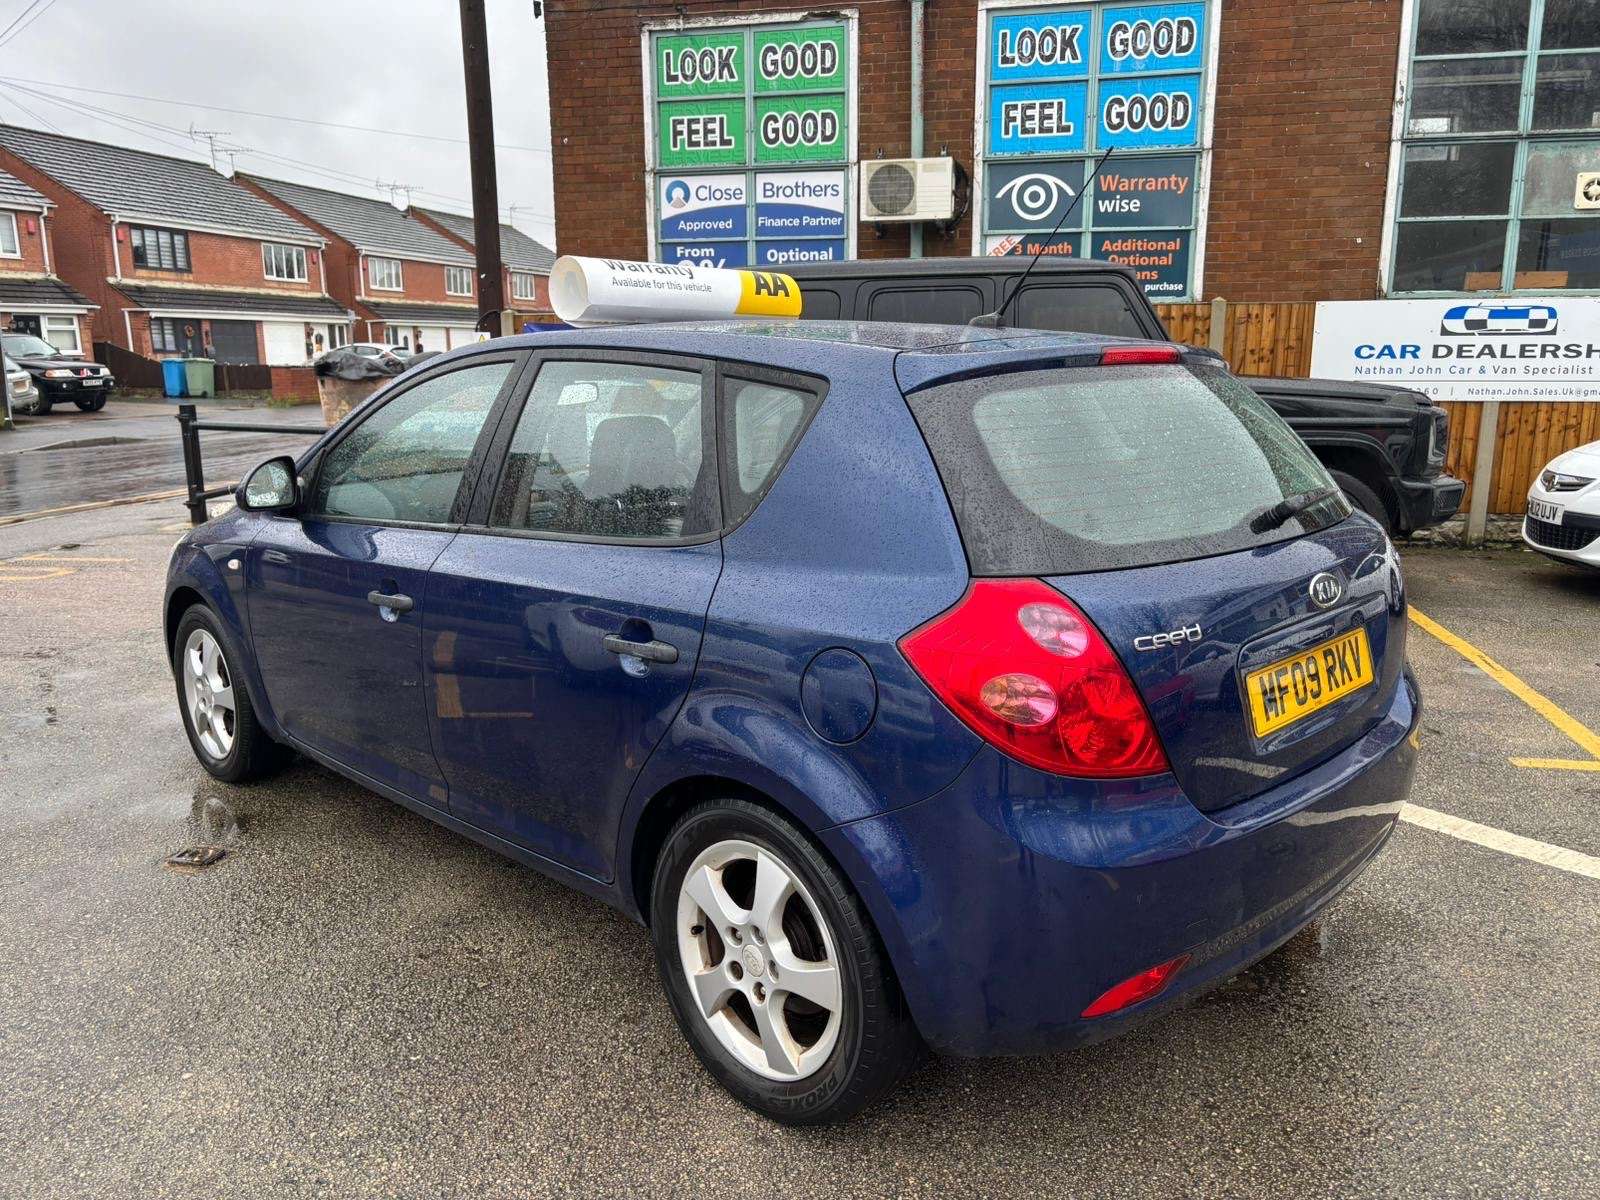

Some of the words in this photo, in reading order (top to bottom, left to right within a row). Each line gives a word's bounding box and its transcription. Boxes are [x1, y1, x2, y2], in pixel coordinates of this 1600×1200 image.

[998, 25, 1080, 65] LOOK
[1109, 18, 1195, 59] GOOD
[665, 47, 737, 83] LOOK
[761, 41, 838, 79] GOOD
[1003, 101, 1072, 136] FEEL
[1105, 94, 1190, 131] GOOD
[671, 115, 734, 149] FEEL
[762, 111, 837, 147] GOOD
[695, 185, 743, 201] Close
[762, 182, 840, 198] Brothers
[1100, 174, 1189, 194] Warranty
[1098, 195, 1141, 213] wise
[678, 218, 733, 231] Approved
[758, 216, 800, 228] Finance
[802, 214, 843, 226] Partner
[676, 246, 715, 258] From
[1014, 244, 1022, 255] 3
[1027, 242, 1073, 255] Month
[1101, 238, 1181, 252] Additional
[766, 247, 833, 263] Optional
[612, 276, 652, 288] Available
[653, 279, 666, 289] for
[667, 280, 683, 291] this
[684, 283, 713, 293] vehicle
[752, 271, 790, 297] AA
[1144, 281, 1184, 293] purchase
[1354, 344, 1421, 359] CAR
[1431, 343, 1600, 359] DEALERSH
[1354, 365, 1402, 375] Nathan
[1409, 365, 1442, 375] John
[1449, 365, 1472, 375] Car
[1478, 365, 1487, 375] &
[1493, 365, 1517, 375] Van
[1523, 365, 1593, 376] Specialist
[1467, 387, 1600, 397] Nathan.John.Sales.Uk@gm
[1315, 579, 1339, 601] KIA
[1323, 635, 1361, 692] RKV
